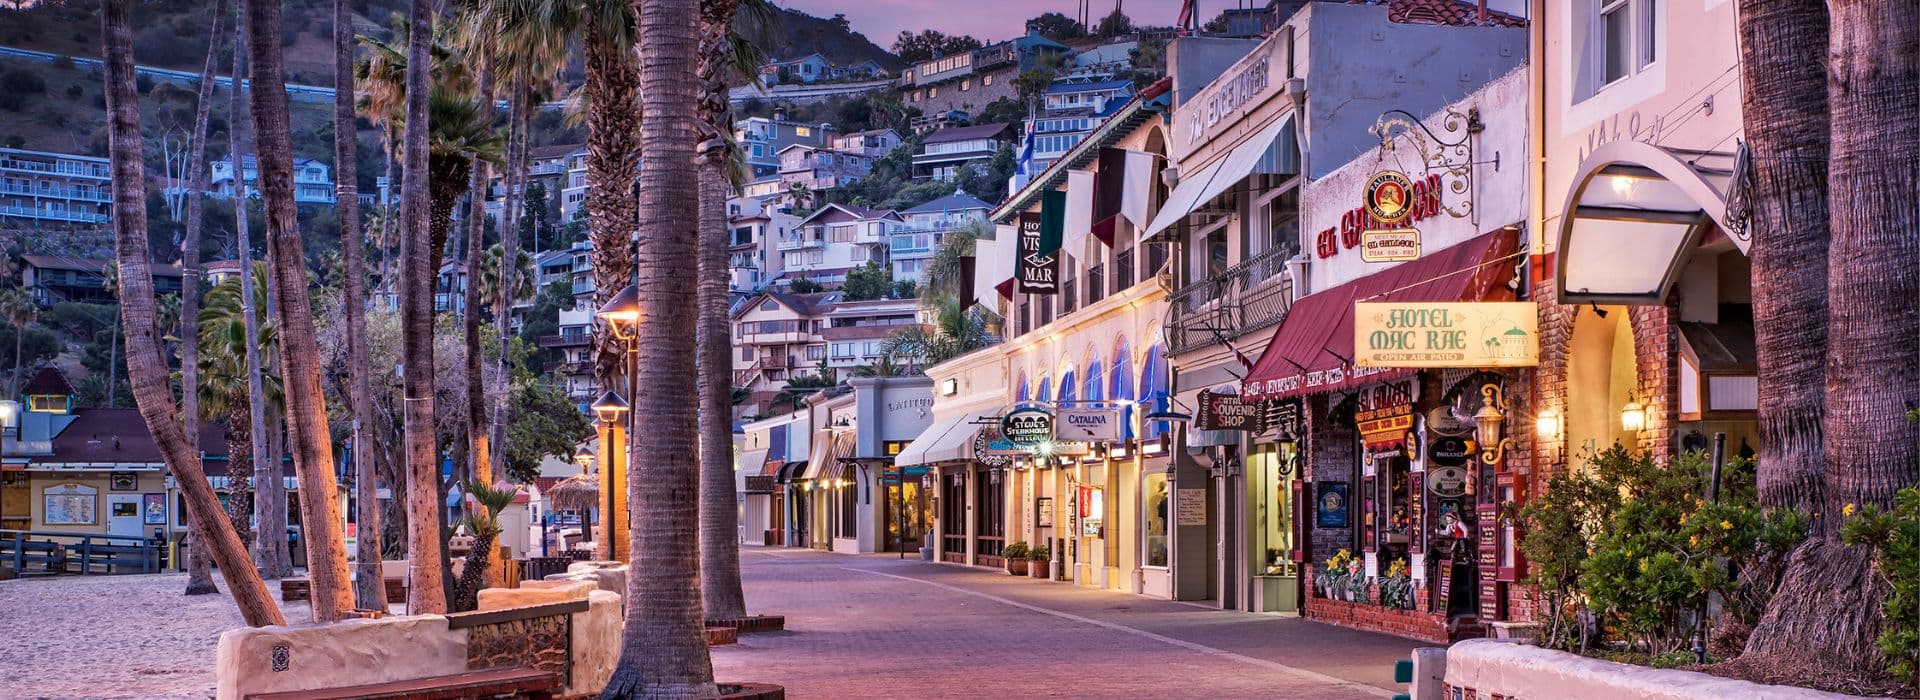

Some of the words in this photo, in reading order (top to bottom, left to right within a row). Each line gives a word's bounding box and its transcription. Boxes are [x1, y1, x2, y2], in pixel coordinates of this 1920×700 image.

[1207, 55, 1269, 129] EDGEWATER
[1025, 267, 1053, 282] MAR
[1386, 308, 1453, 329] HOTEL
[1369, 330, 1416, 350] MAC
[1427, 330, 1466, 350] RAE
[1379, 353, 1407, 361] OPEN
[1411, 353, 1427, 361] AIR
[1430, 353, 1458, 361] PATIO
[888, 398, 934, 412] LATITUD
[1212, 403, 1256, 417] SOUVENIR
[1068, 414, 1107, 424] CATALINA
[1218, 415, 1245, 427] SHOP
